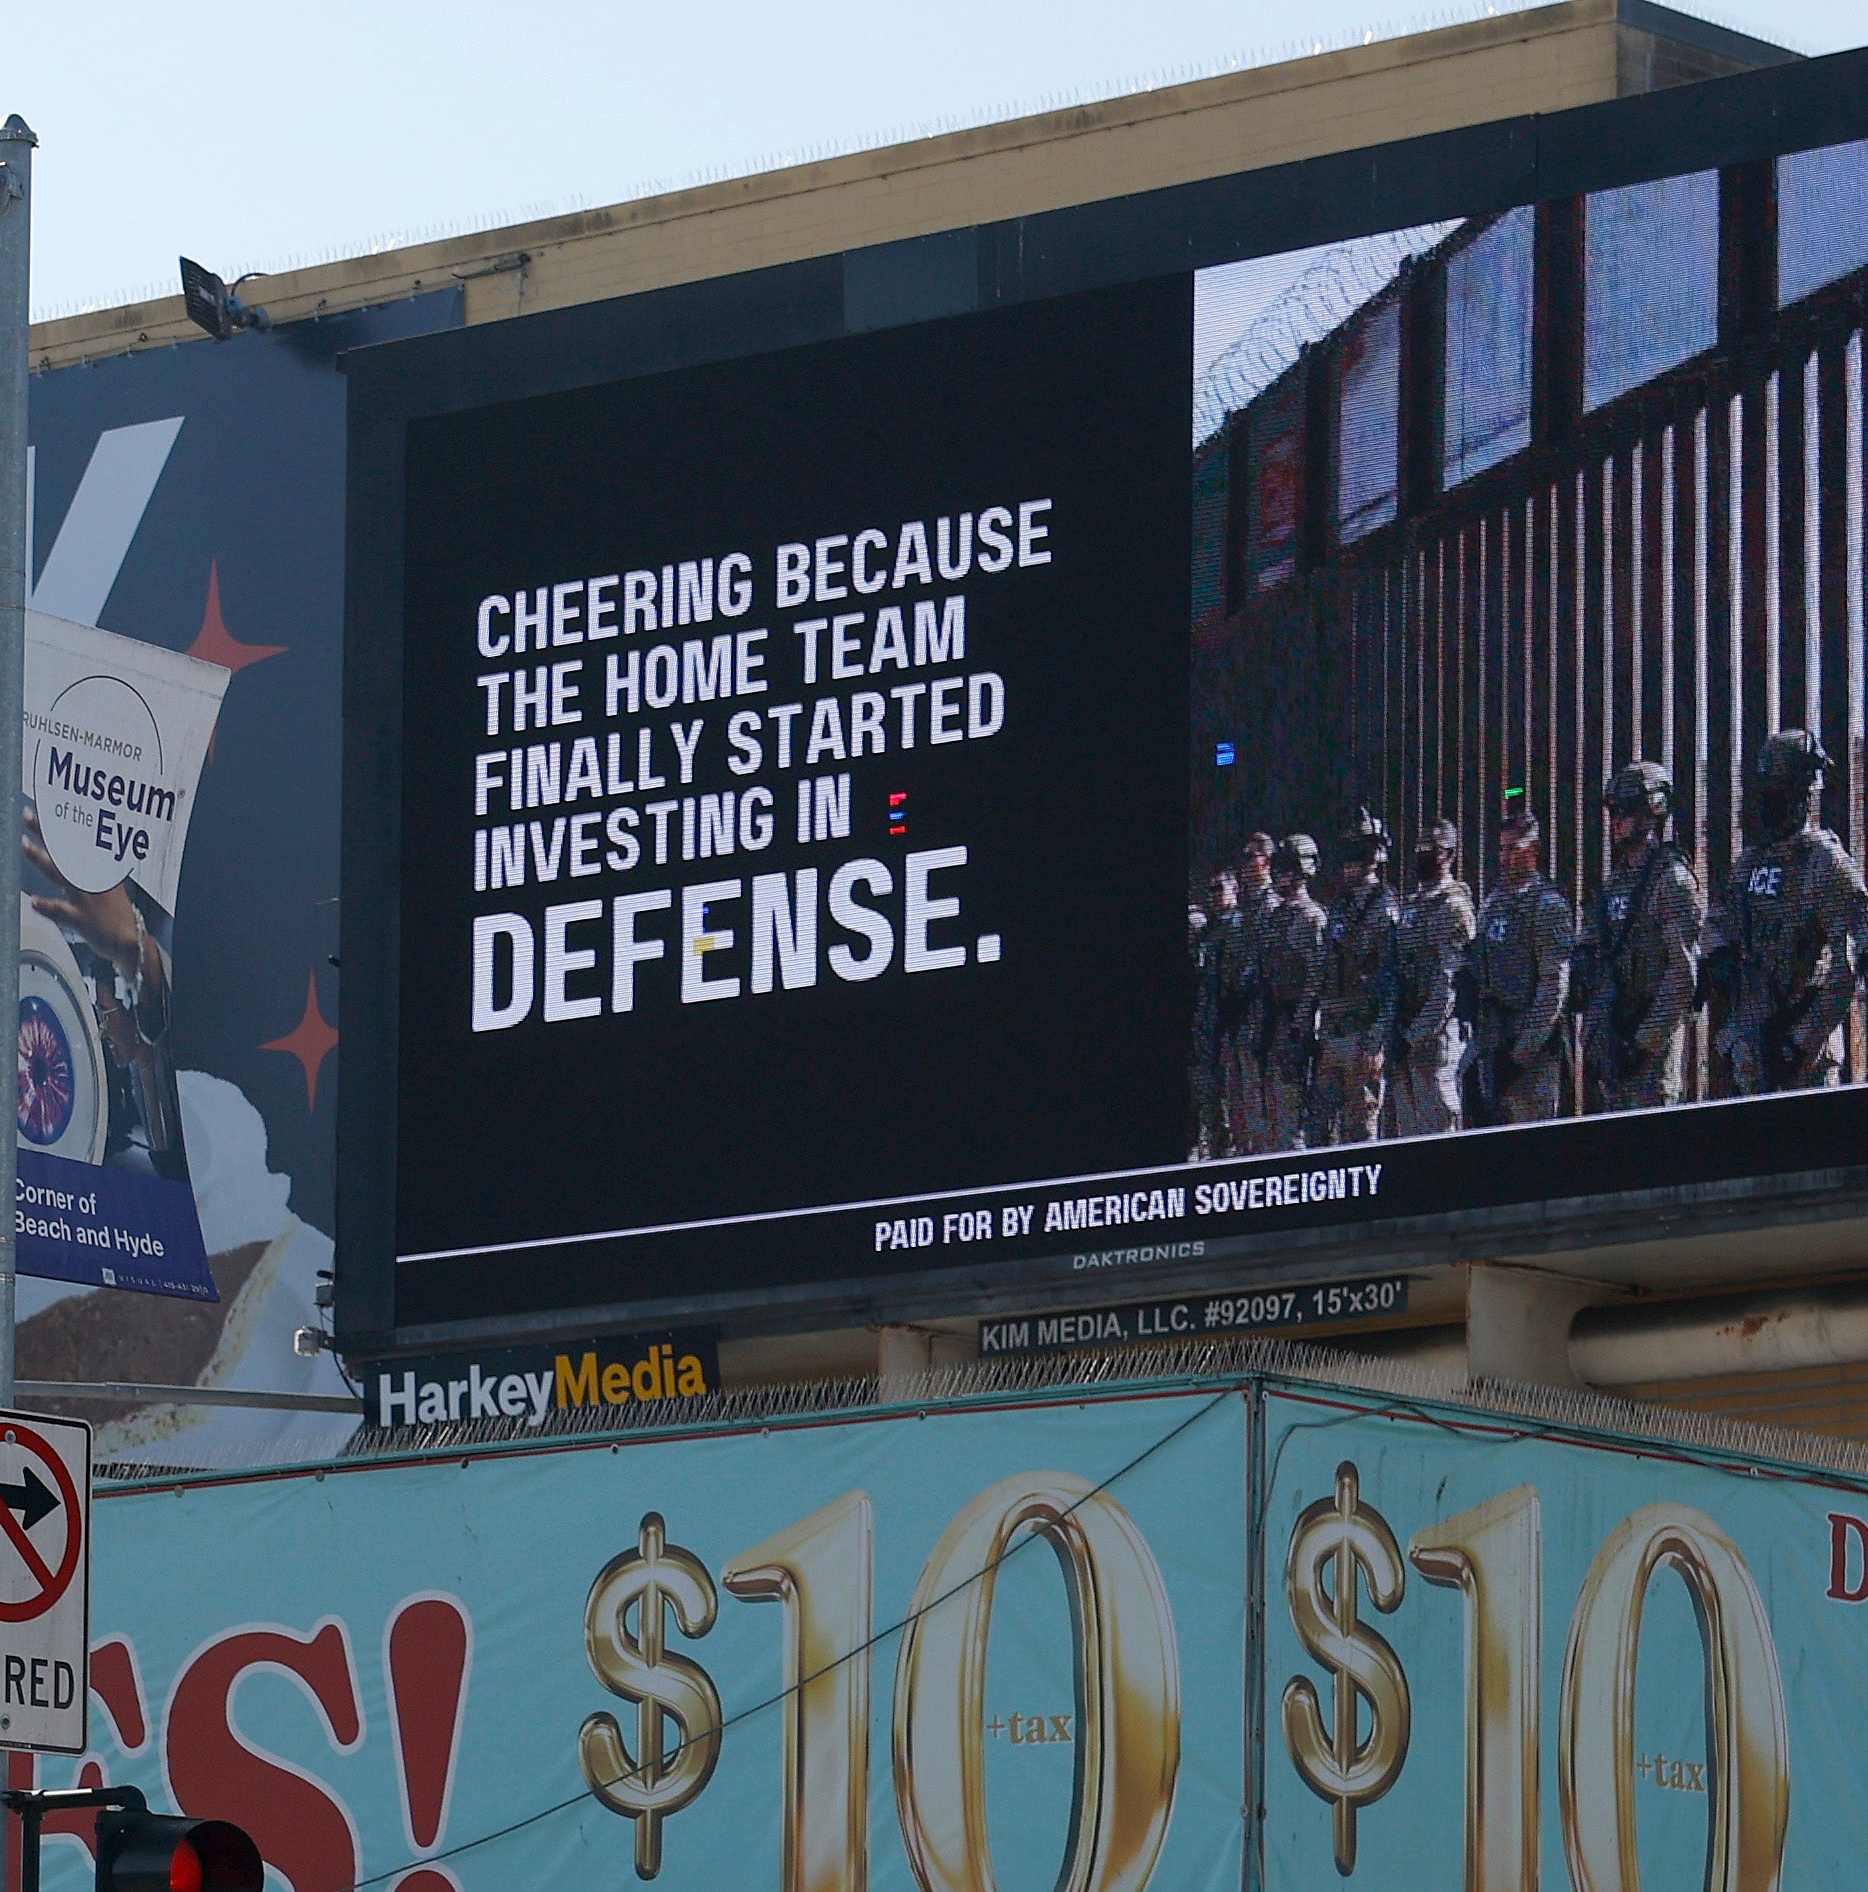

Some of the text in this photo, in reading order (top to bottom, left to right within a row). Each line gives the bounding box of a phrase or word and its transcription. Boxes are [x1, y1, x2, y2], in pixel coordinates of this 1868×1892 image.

[476, 498, 1052, 658] CHEERING BECAUSE
[477, 595, 966, 736] THE HOME TEAM
[474, 670, 1006, 816] FINALLY STARTED
[48, 746, 176, 822] Museum
[55, 802, 149, 862] of the Eye
[473, 773, 852, 892] INVESTING IN
[1749, 865, 1782, 898] ICE
[472, 845, 1002, 1032] DEFENSE.
[16, 1178, 98, 1216] Corner of
[874, 1163, 1383, 1252] PAID FOR BY AMERICAN SOVEREIGNTY
[15, 1211, 165, 1258] Beach and Hyde
[1073, 1241, 1206, 1270] DAKTRONICS
[982, 1280, 1403, 1353] KIM MEDIA, LLC. #92097, 15'x30'
[378, 1344, 705, 1428] HarkeyMedia
[5, 1654, 75, 1710] RED
[986, 1704, 1074, 1747] +tax
[1636, 1750, 1706, 1795] +tax
